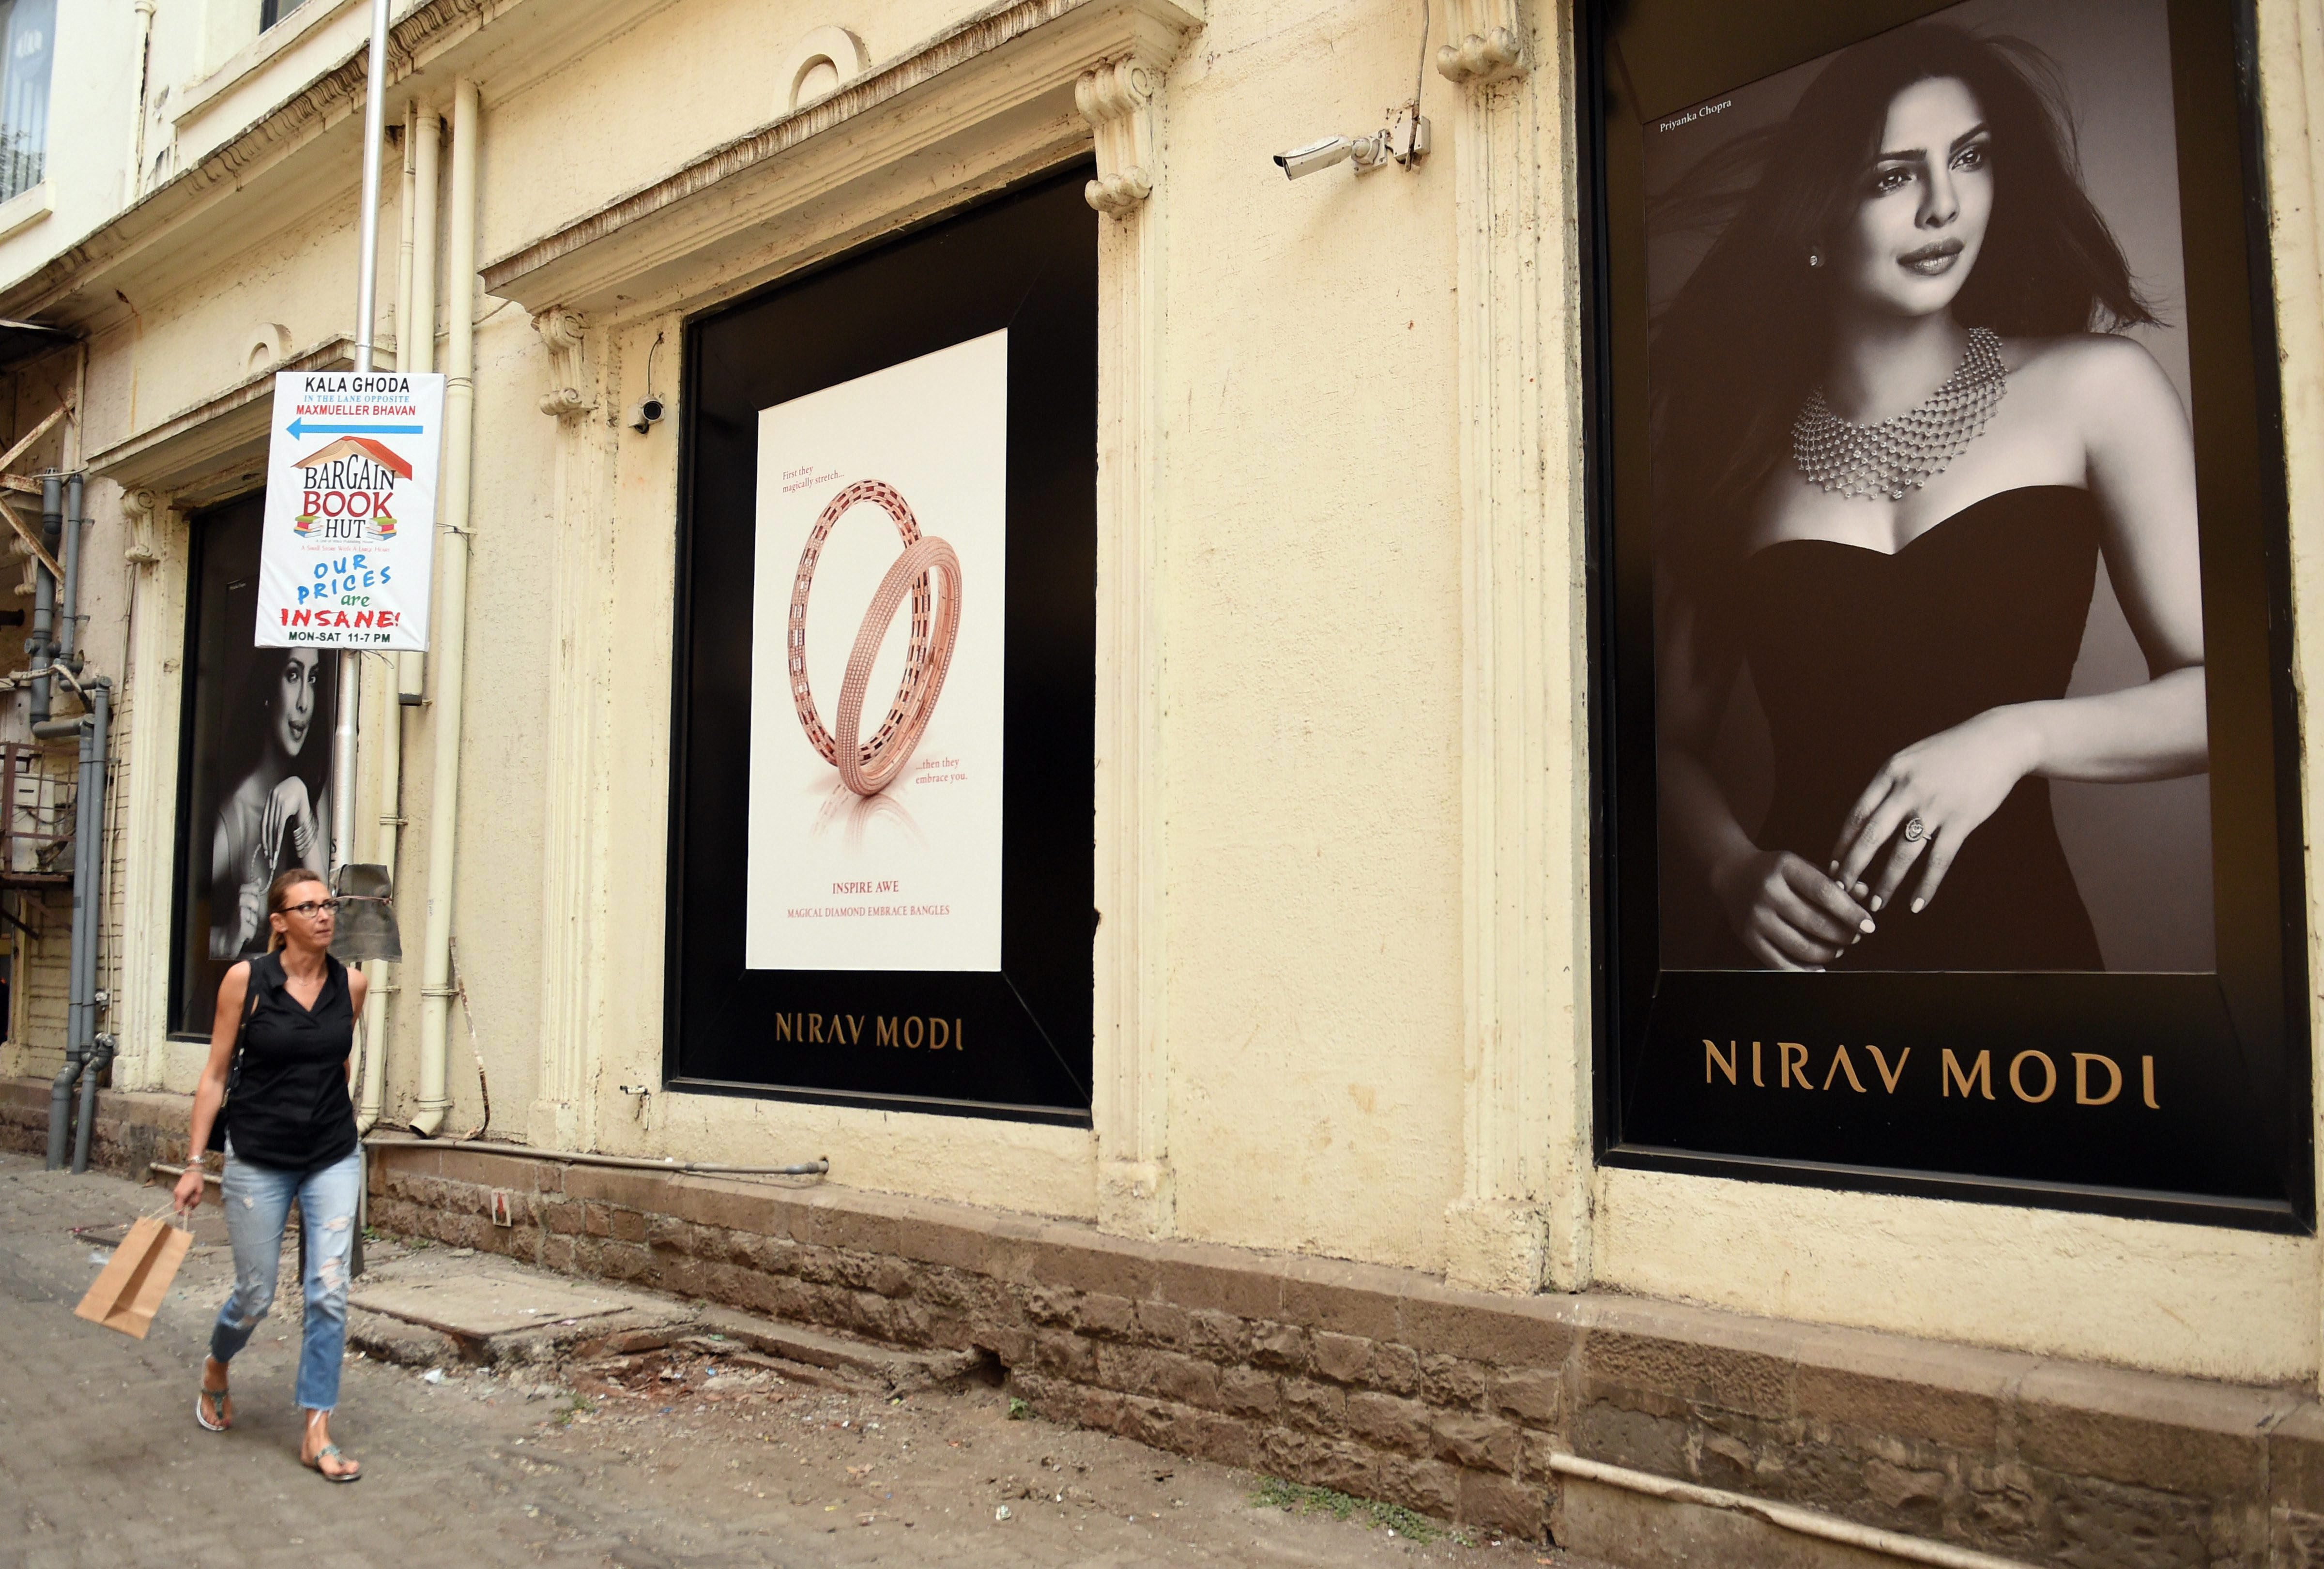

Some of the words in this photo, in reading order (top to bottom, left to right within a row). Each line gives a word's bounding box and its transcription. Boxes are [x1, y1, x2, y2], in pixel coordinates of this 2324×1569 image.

[1660, 113, 1697, 132] Priyanka
[1699, 100, 1731, 117] Chopra
[305, 377, 347, 393] KALA
[352, 377, 410, 393] GHODA
[296, 405, 369, 415] MAXMUELLER
[372, 405, 416, 416] BHAVAN
[303, 454, 396, 490] BARGAIN
[782, 471, 797, 480] First
[799, 466, 814, 476] they
[782, 477, 814, 493] magically
[815, 470, 844, 484] stretch...
[303, 490, 394, 518] BOOK
[324, 519, 366, 538] HUT
[314, 554, 367, 579] OUR
[297, 566, 391, 605] PRICES
[340, 595, 370, 607] are
[279, 608, 401, 628] INSANE!
[289, 631, 342, 642] MON-SAT
[348, 633, 370, 642] 11-7
[374, 633, 390, 643] PM
[916, 759, 940, 770] ...then
[942, 757, 960, 769] they
[916, 773, 948, 784] embrace
[950, 774, 968, 784] you.
[832, 882, 872, 894] INSPIRE
[875, 881, 899, 893] AWE
[787, 908, 822, 918] MAGICAL
[825, 907, 866, 917] DIAMOND
[868, 906, 907, 916] EMBRACE
[910, 905, 950, 915] BANGLES
[776, 1012, 865, 1045] NIRAV
[876, 1015, 963, 1051] MODI
[1702, 1039, 1911, 1095] NIRAV
[1942, 1048, 2160, 1109] MODI
